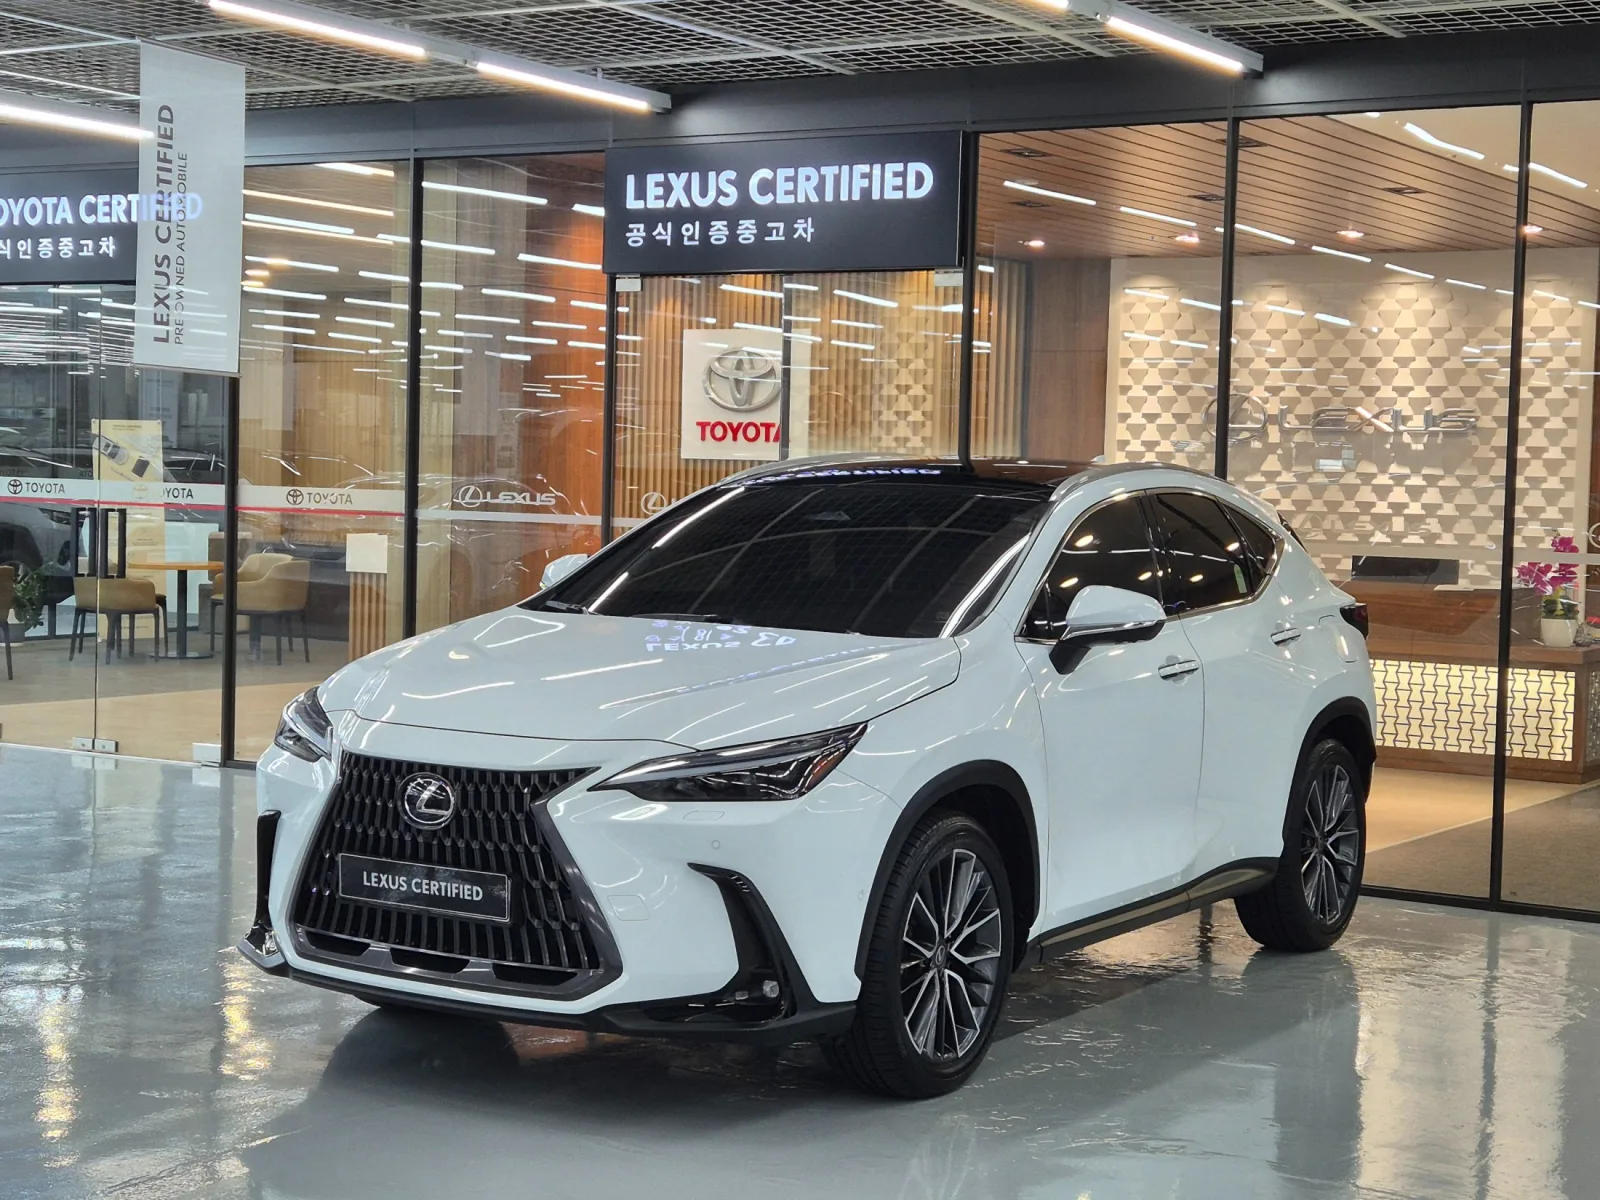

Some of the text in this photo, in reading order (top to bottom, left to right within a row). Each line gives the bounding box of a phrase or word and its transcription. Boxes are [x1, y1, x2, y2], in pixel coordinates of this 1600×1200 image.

[155, 104, 174, 244] CERTIFIED
[625, 162, 934, 209] LEXUS CERTIFIED
[176, 151, 188, 252] AUTOMOBILE
[625, 217, 815, 247] 공식인증중고차
[153, 253, 171, 344] LEXUS
[1278, 404, 1477, 432] LEXUS
[25, 482, 65, 494] TOYOTA
[307, 492, 353, 505] TOYOTA
[487, 490, 556, 506] LEXUS
[363, 871, 483, 901] LEXUS CERTIFIED
